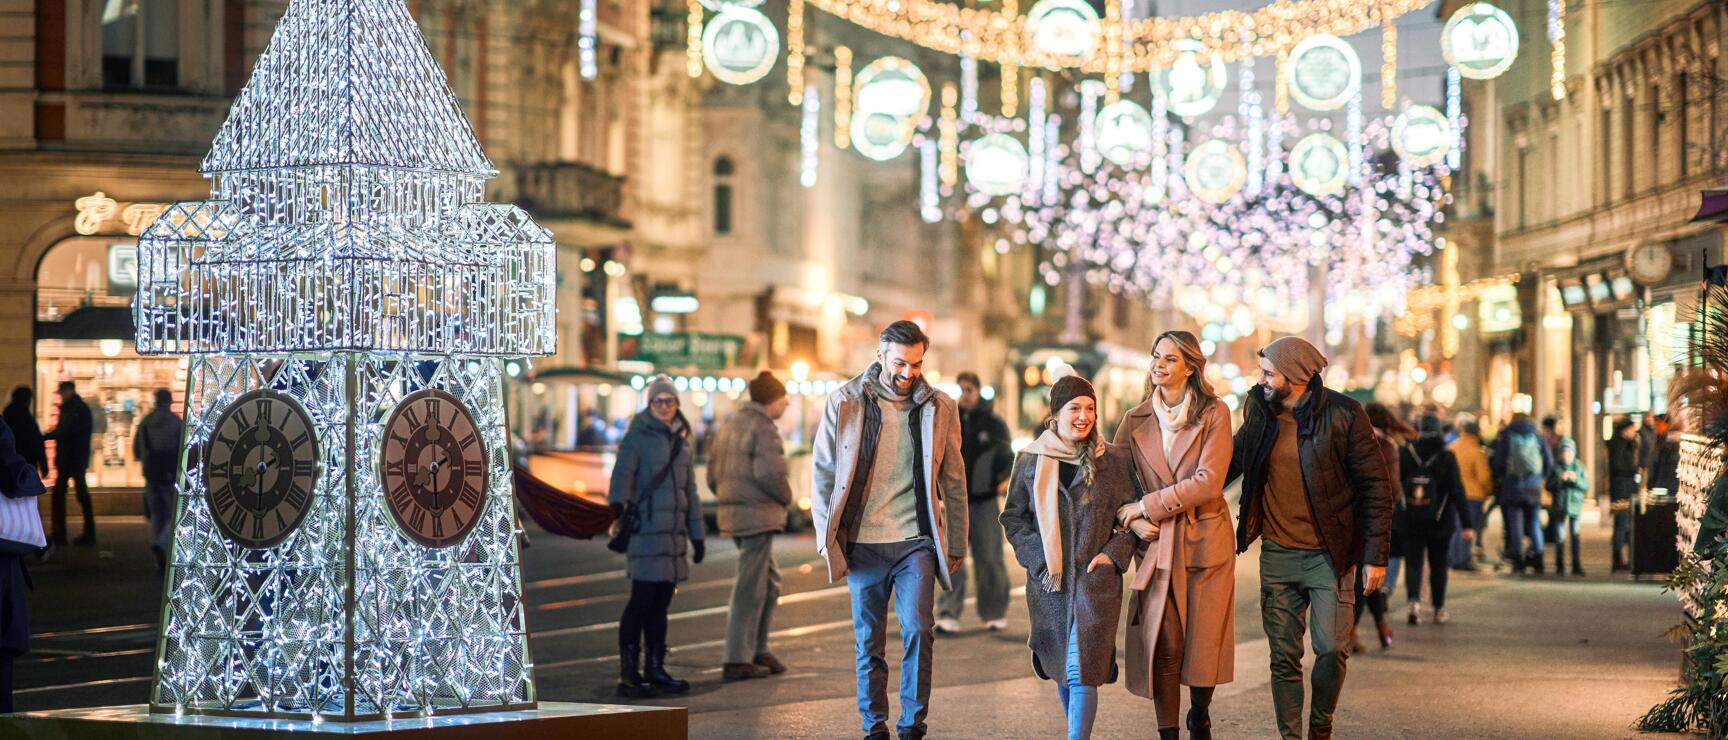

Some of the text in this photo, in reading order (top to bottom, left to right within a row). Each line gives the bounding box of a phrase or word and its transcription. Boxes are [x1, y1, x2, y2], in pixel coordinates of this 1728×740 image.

[231, 408, 251, 435] XI
[279, 408, 293, 431] I
[402, 406, 421, 434] XI
[447, 408, 459, 431] I
[216, 432, 236, 451] X
[290, 431, 309, 452] II
[390, 430, 409, 451] X
[459, 431, 476, 451] II
[211, 461, 229, 478] IX
[294, 460, 313, 477] III
[387, 460, 403, 477] IX
[465, 460, 482, 477] III
[228, 504, 248, 534] VII
[275, 508, 287, 531] V
[409, 503, 426, 533] VII
[451, 507, 464, 530] V
